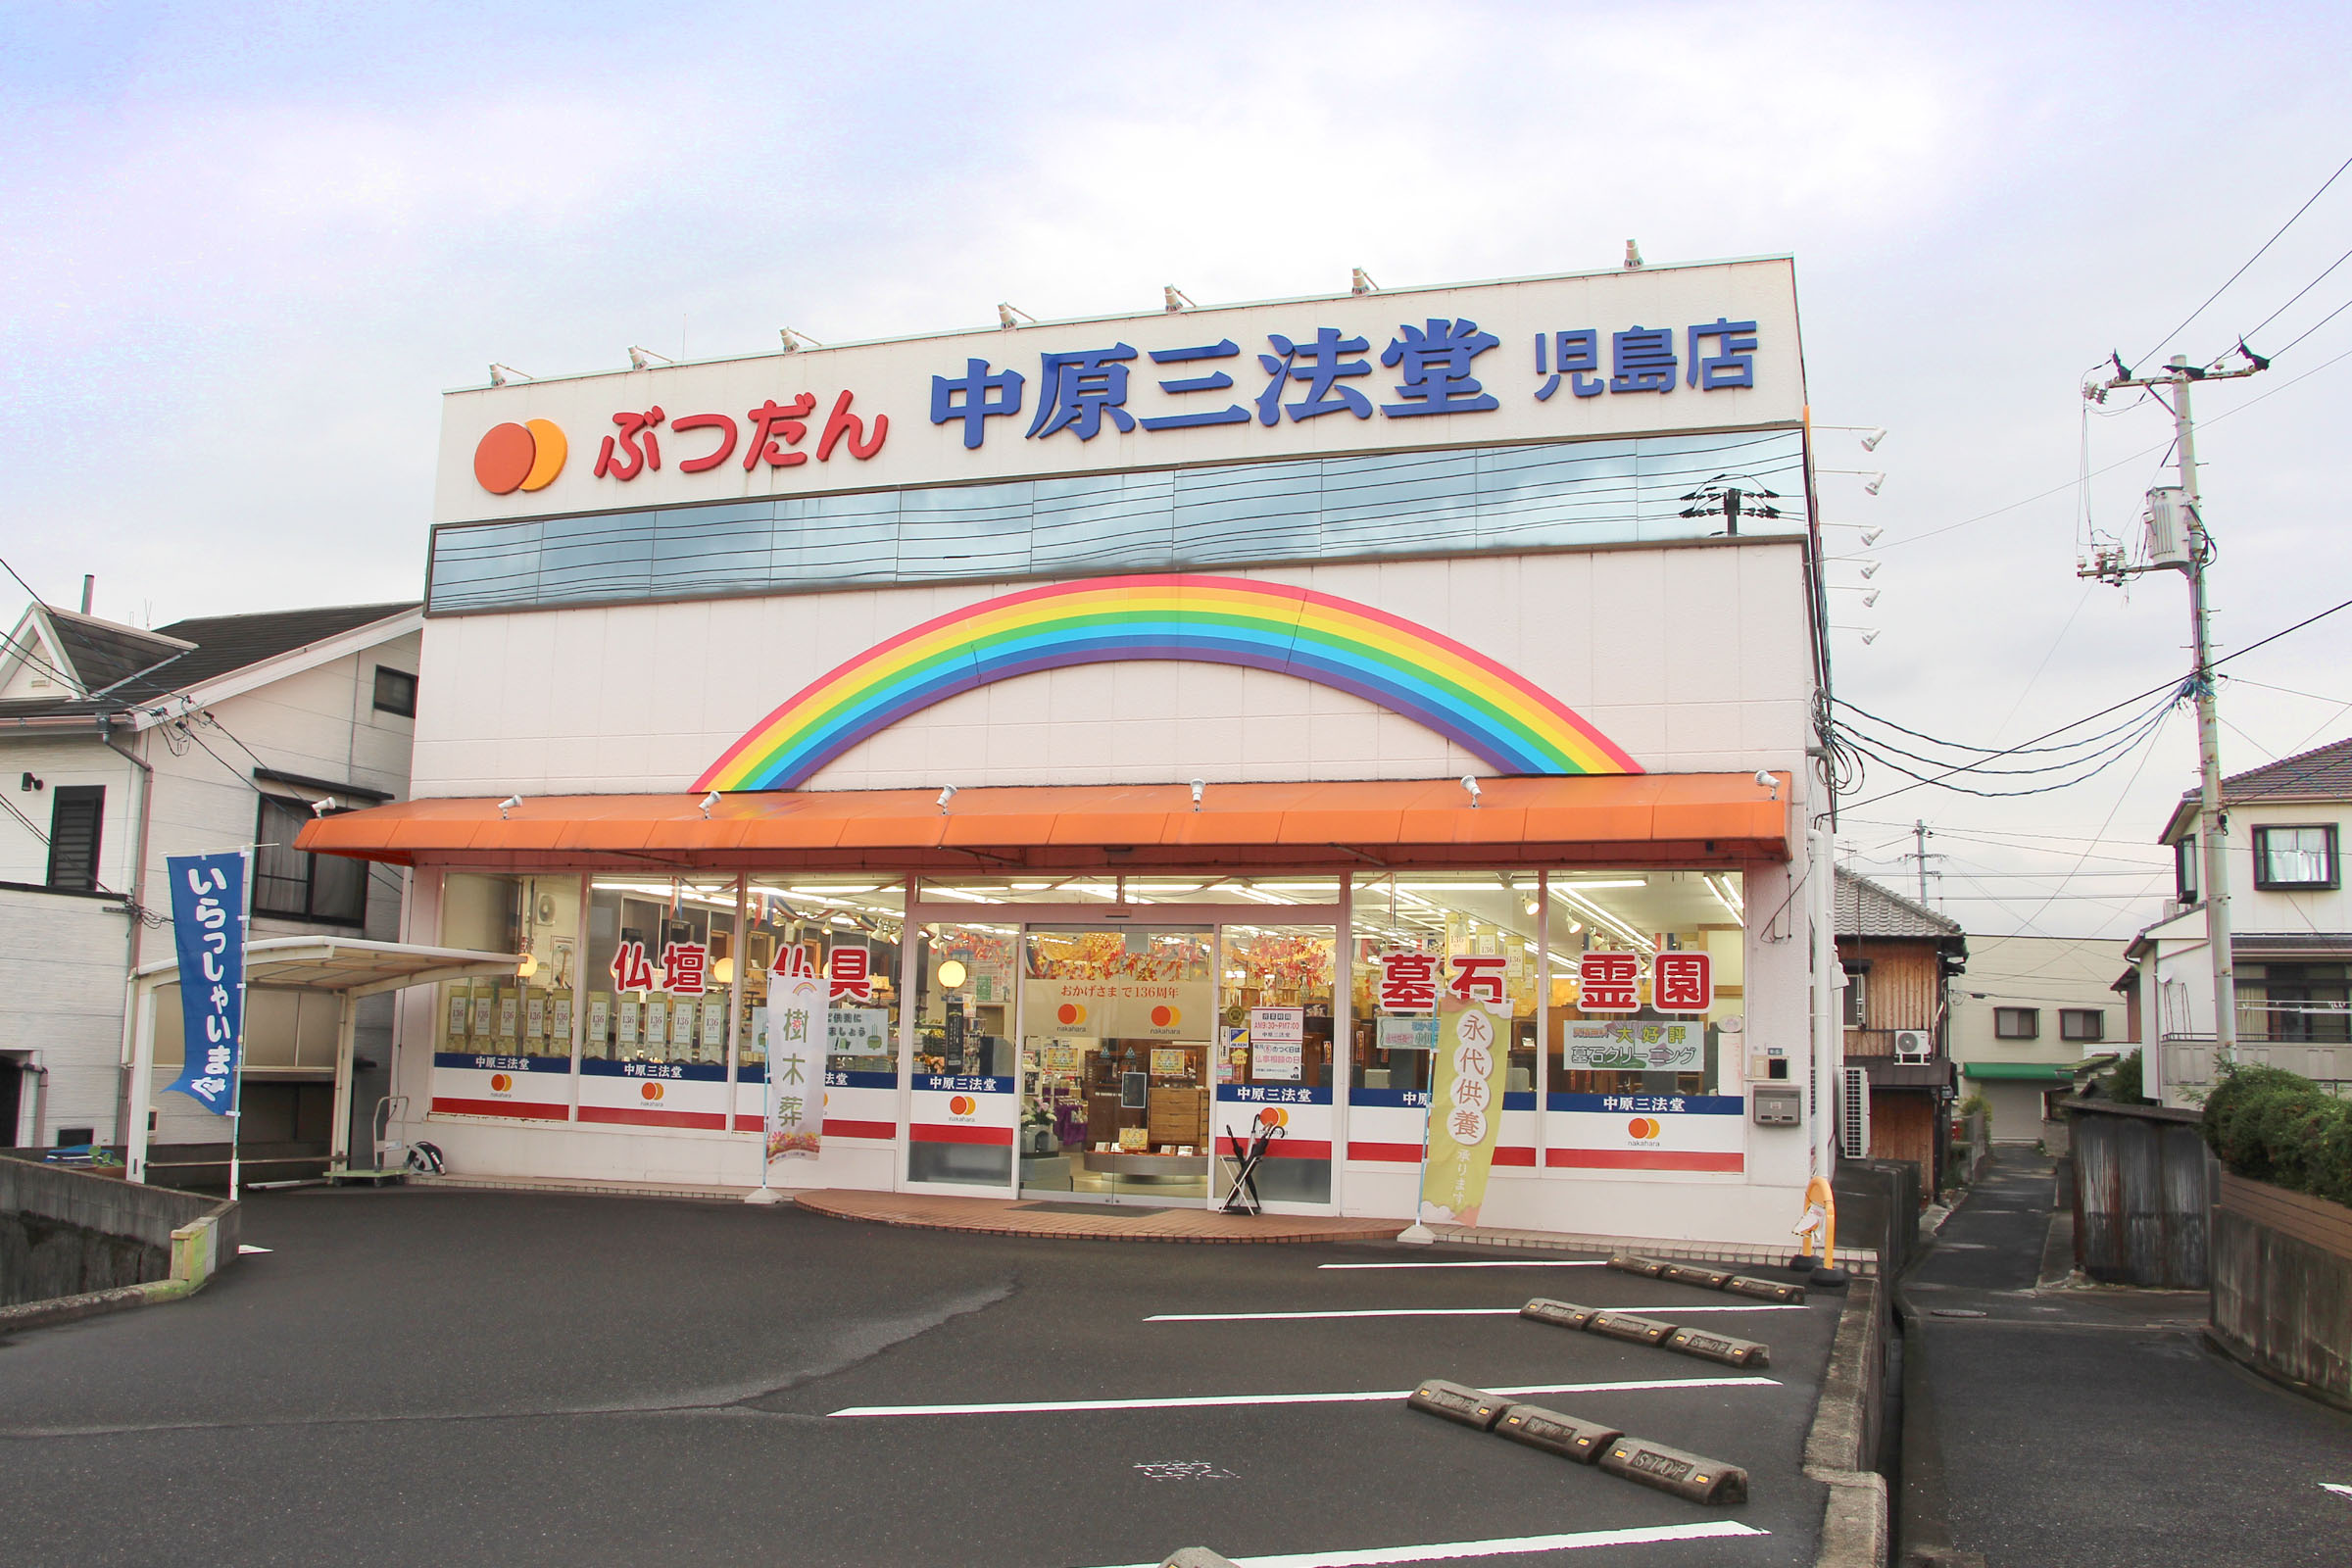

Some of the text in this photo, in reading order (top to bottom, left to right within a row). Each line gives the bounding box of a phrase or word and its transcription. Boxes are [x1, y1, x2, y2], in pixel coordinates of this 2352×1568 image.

[594, 318, 1757, 481] ぶつだん 中原三法堂 児島店
[613, 943, 707, 994] 仏壇
[1382, 953, 1506, 1008] 墓石
[1581, 954, 1710, 1010] 霊園
[187, 867, 231, 1102] いらっしゃいませ
[475, 1055, 530, 1071] 中原三法堂
[776, 1007, 809, 1127] 樹木葬
[1570, 1045, 1697, 1065] 墓石クリーニング
[623, 1062, 683, 1079] 中原三法堂
[929, 1075, 998, 1092] 中原三法堂
[1452, 1012, 1488, 1139] 永代供養
[1237, 1086, 1313, 1103] 中原三法堂
[1602, 1096, 1686, 1113] 中原三法堂
[1627, 1139, 1660, 1148] nakahara
[1633, 1450, 1689, 1480] STOP
